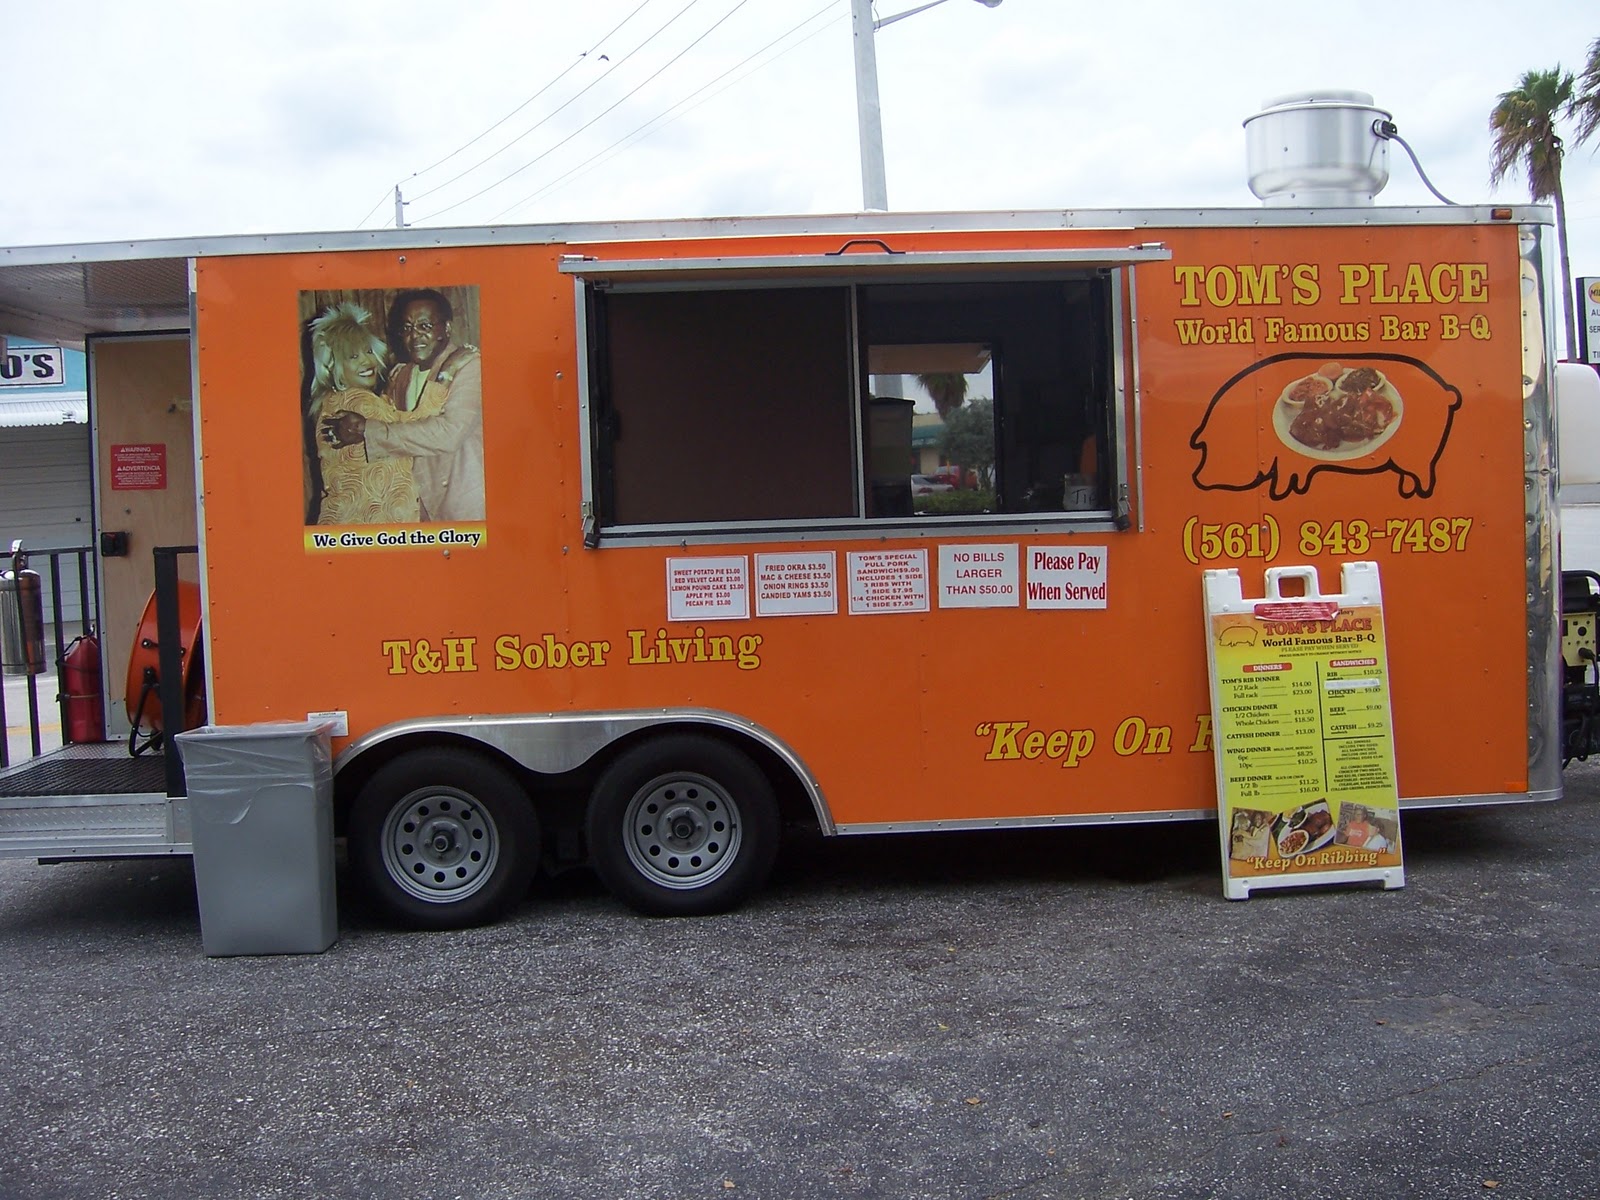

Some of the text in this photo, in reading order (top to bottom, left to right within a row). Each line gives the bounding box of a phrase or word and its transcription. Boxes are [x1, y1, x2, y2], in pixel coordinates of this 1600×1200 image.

[1175, 263, 1489, 306] TOM'S PLACE
[1175, 315, 1492, 345] World Famous Bar B-Q
[314, 530, 481, 547] We Give God the Glory
[1182, 514, 1473, 564] (561) 843-7487
[954, 553, 1004, 562] NO BILLS
[1034, 552, 1100, 574] Please Pay
[956, 569, 1002, 578] LARGER
[946, 585, 1013, 594] THAN $50.00
[1028, 582, 1105, 600] When Served
[1263, 618, 1372, 636] TOM'S PLACE
[1262, 633, 1376, 647] World Famous Bar-B-Q
[382, 627, 763, 675] T&H Sober Living
[1113, 716, 1172, 757] On
[1295, 854, 1316, 866] On
